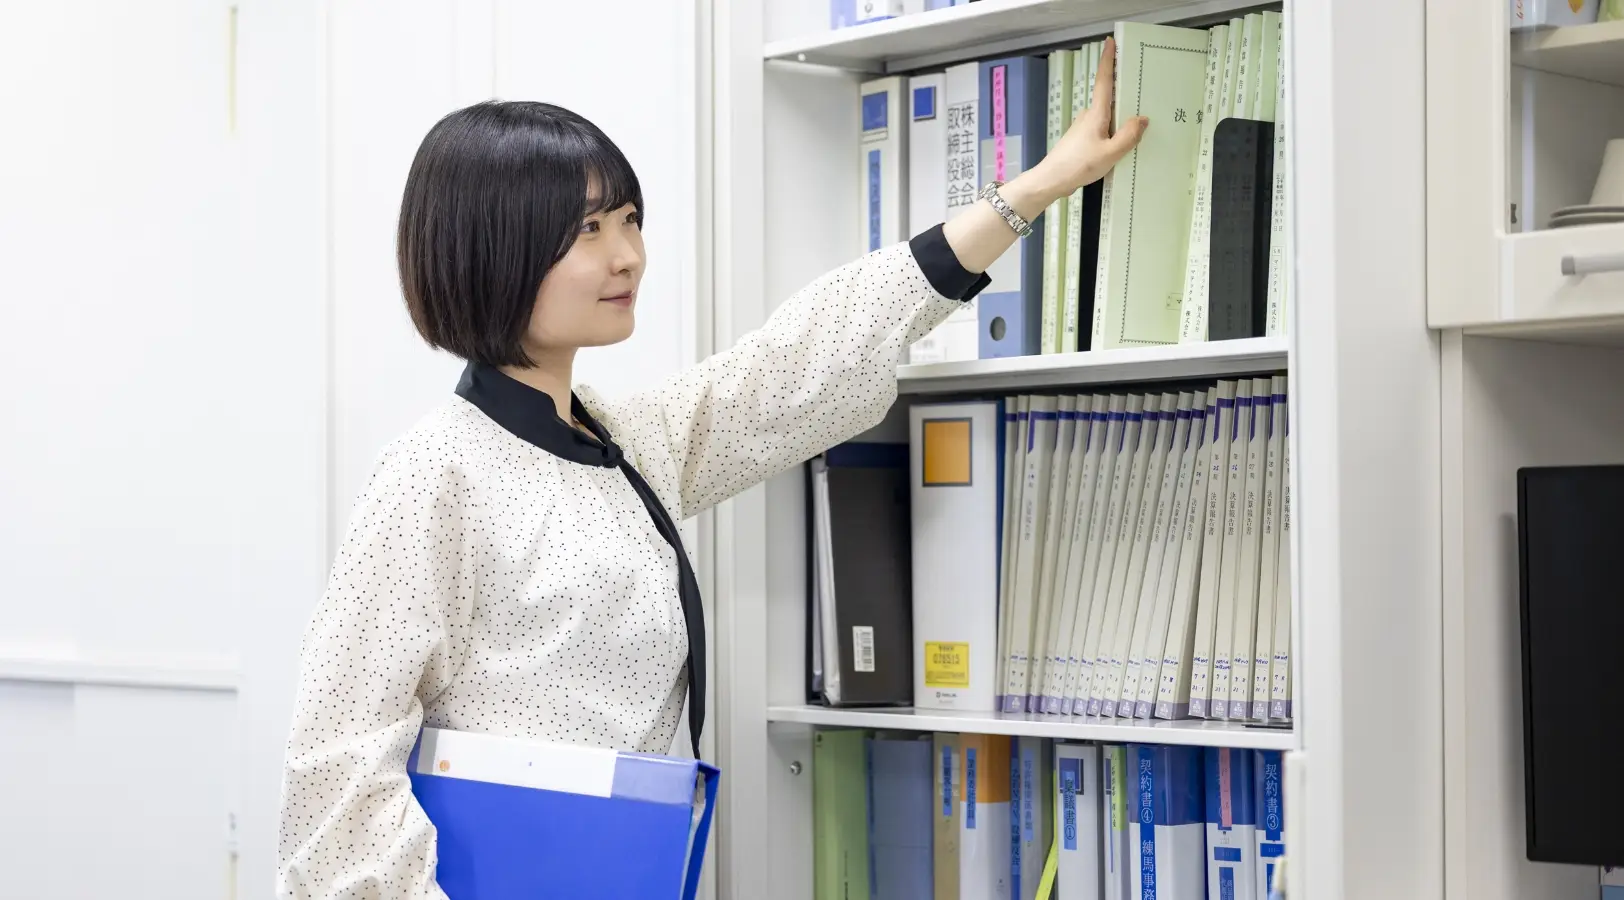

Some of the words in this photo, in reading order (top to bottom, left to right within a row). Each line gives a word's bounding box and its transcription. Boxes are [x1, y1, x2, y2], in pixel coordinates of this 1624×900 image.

[947, 107, 960, 208] 取締役会
[961, 103, 975, 206] 株主総会
[1140, 758, 1154, 824] 契約書④
[1265, 763, 1279, 830] 契約書③
